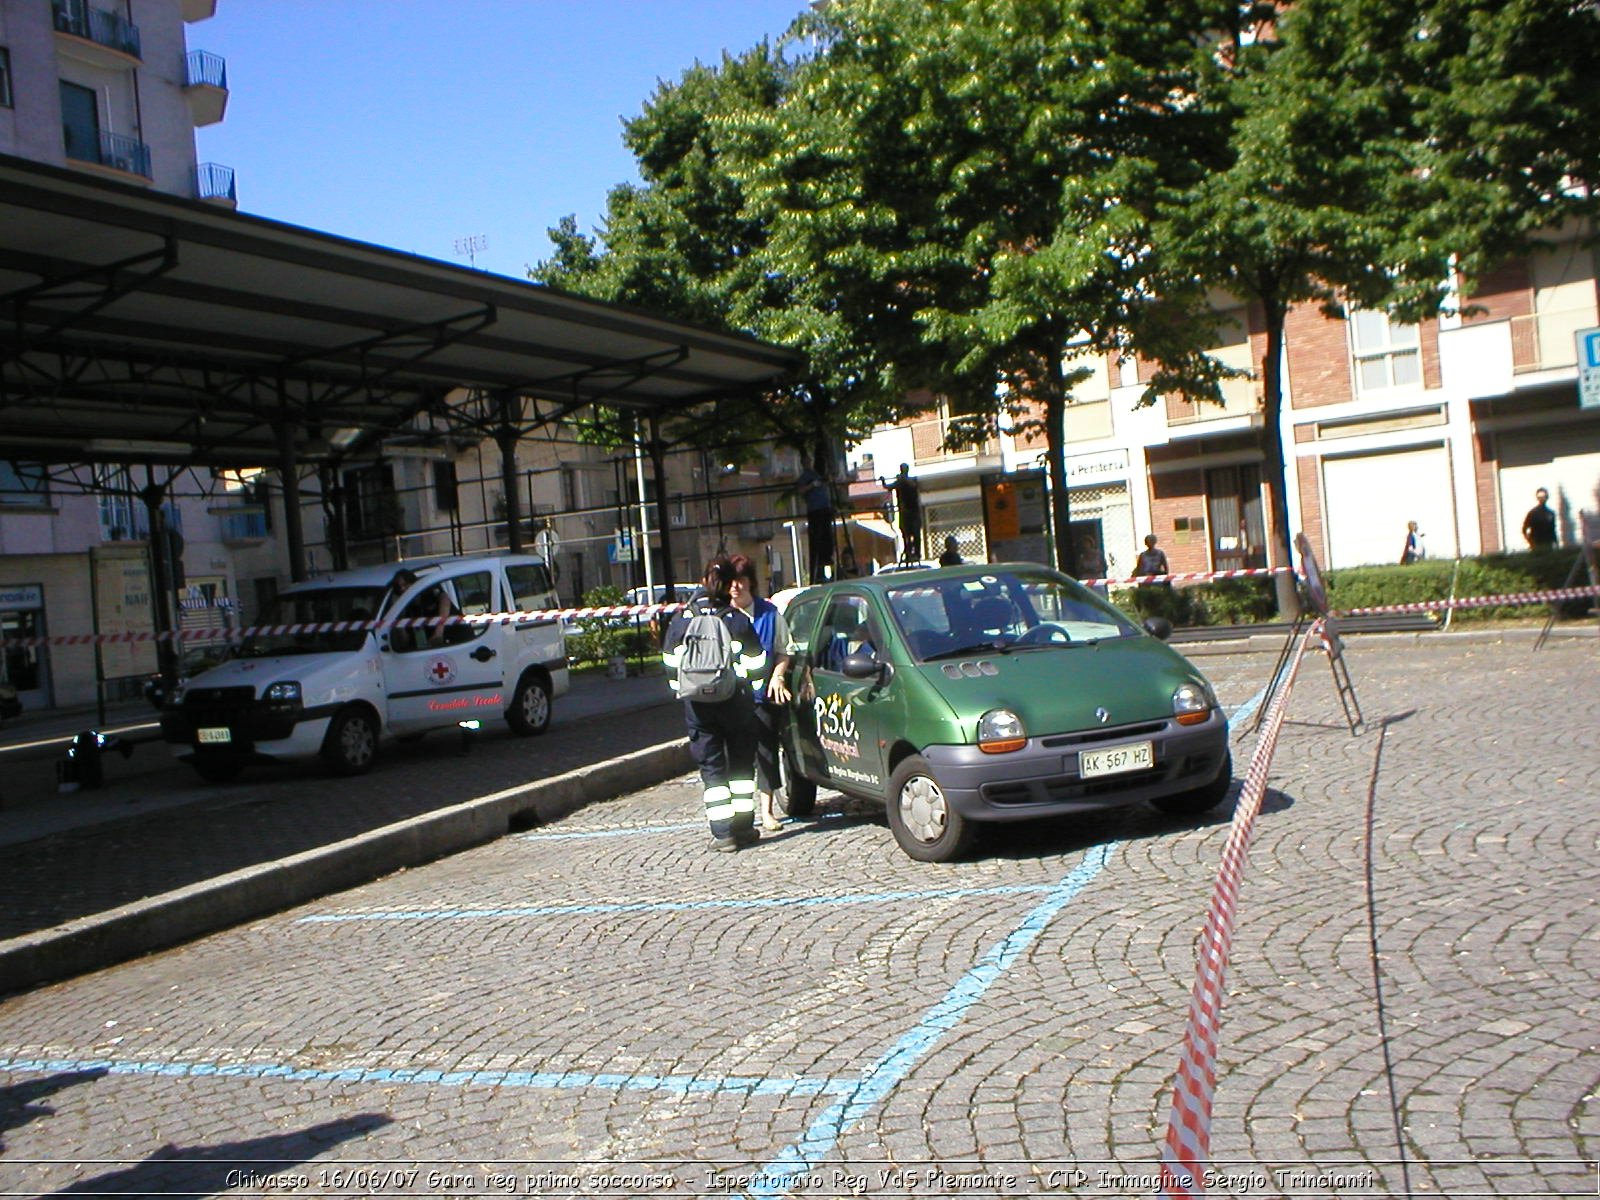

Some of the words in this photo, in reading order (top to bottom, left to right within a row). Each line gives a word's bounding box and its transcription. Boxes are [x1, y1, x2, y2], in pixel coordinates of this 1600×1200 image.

[1085, 756, 1100, 771] AK
[1106, 752, 1128, 768] 567
[1133, 748, 1148, 764] HZ
